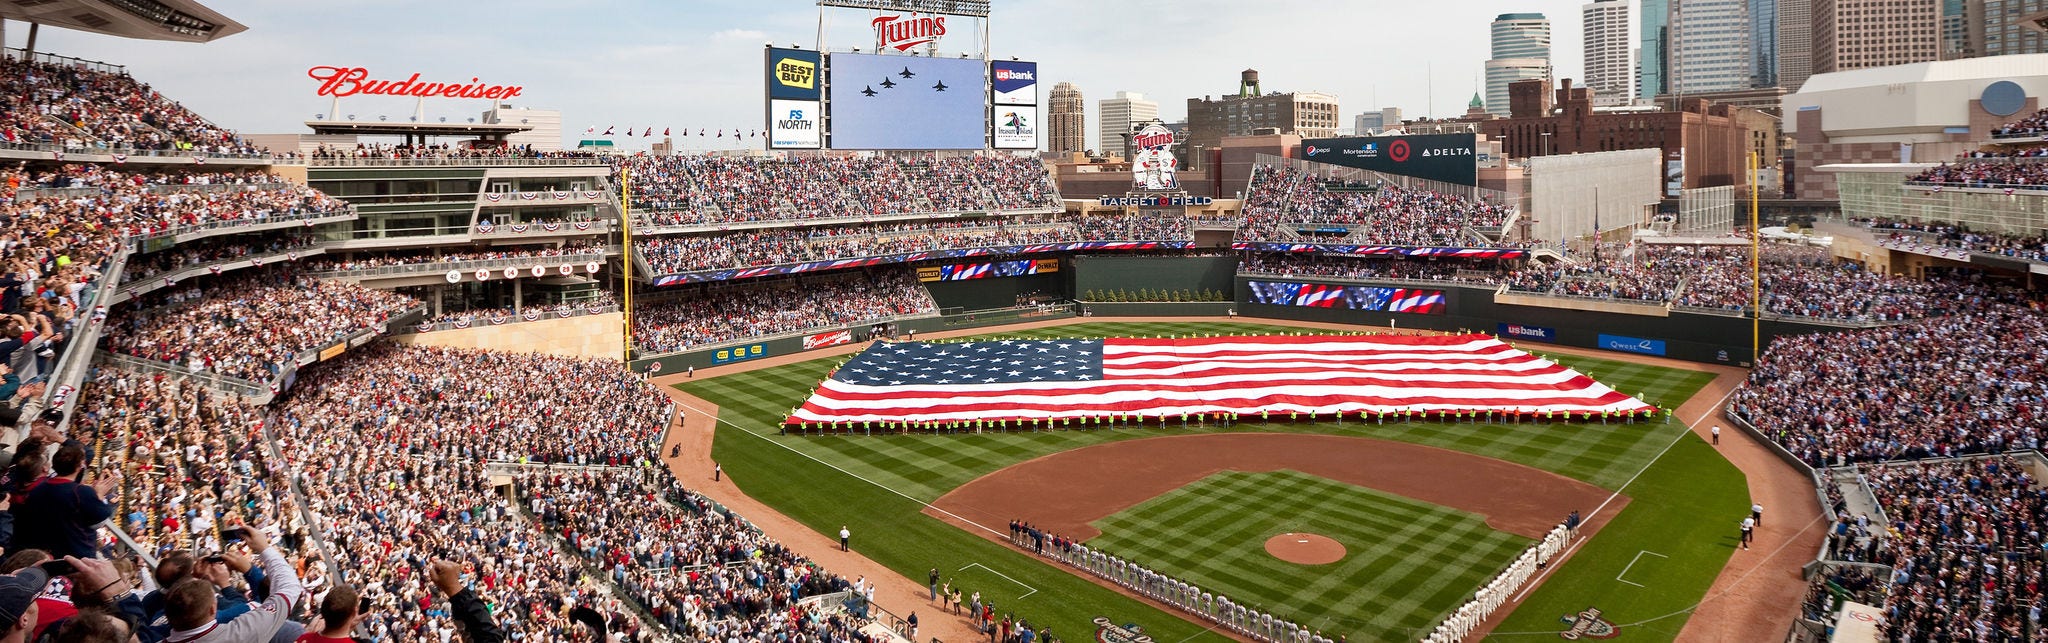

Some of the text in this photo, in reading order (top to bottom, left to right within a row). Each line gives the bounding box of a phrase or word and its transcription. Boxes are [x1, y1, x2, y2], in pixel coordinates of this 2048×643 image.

[872, 12, 946, 47] Twins
[781, 62, 813, 75] BEST
[308, 66, 522, 99] Budweiser
[781, 72, 810, 84] BUY
[789, 110, 803, 119] FS
[778, 119, 812, 130] NORTH
[1134, 132, 1173, 151] Twins
[1433, 148, 1471, 156] DELTA
[1100, 197, 1213, 206] TARGET FIELD
[1610, 340, 1637, 350] Qwest
